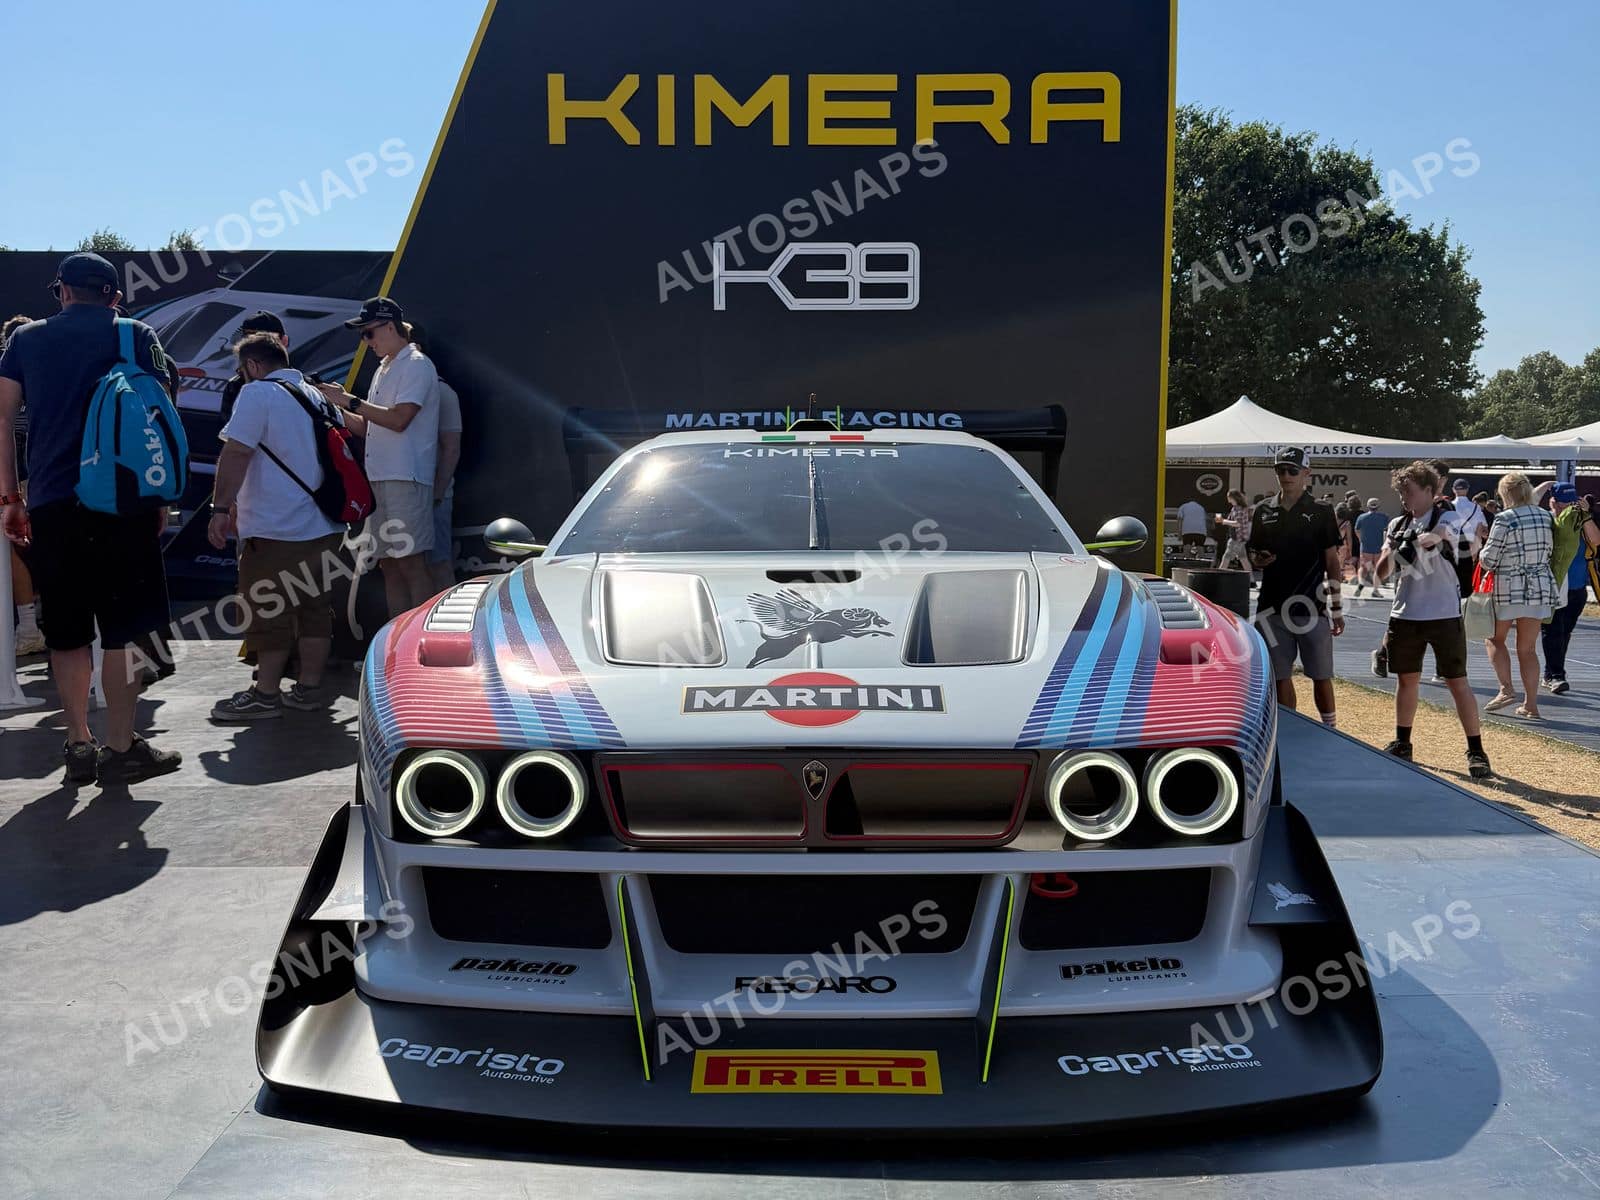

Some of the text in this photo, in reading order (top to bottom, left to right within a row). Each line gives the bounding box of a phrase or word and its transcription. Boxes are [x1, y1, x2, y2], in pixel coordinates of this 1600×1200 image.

[547, 71, 1122, 146] KIMERA
[713, 242, 921, 310] K39
[724, 448, 899, 458] KIMERA
[1303, 446, 1372, 455] CLASSICS
[1310, 473, 1348, 486] TWR
[693, 688, 933, 709] MARTINI
[450, 957, 579, 976] pakelo
[1060, 957, 1184, 980] pakelo
[488, 975, 567, 985] LUBRICANTS
[734, 976, 897, 994] RECARO
[1108, 973, 1188, 983] LUBRICANTS
[378, 1038, 566, 1075] Capristo
[1057, 1043, 1254, 1076] Capristo
[704, 1056, 928, 1088] PIRELLI
[1190, 1059, 1263, 1074] Automotive
[480, 1069, 555, 1085] Automotive
